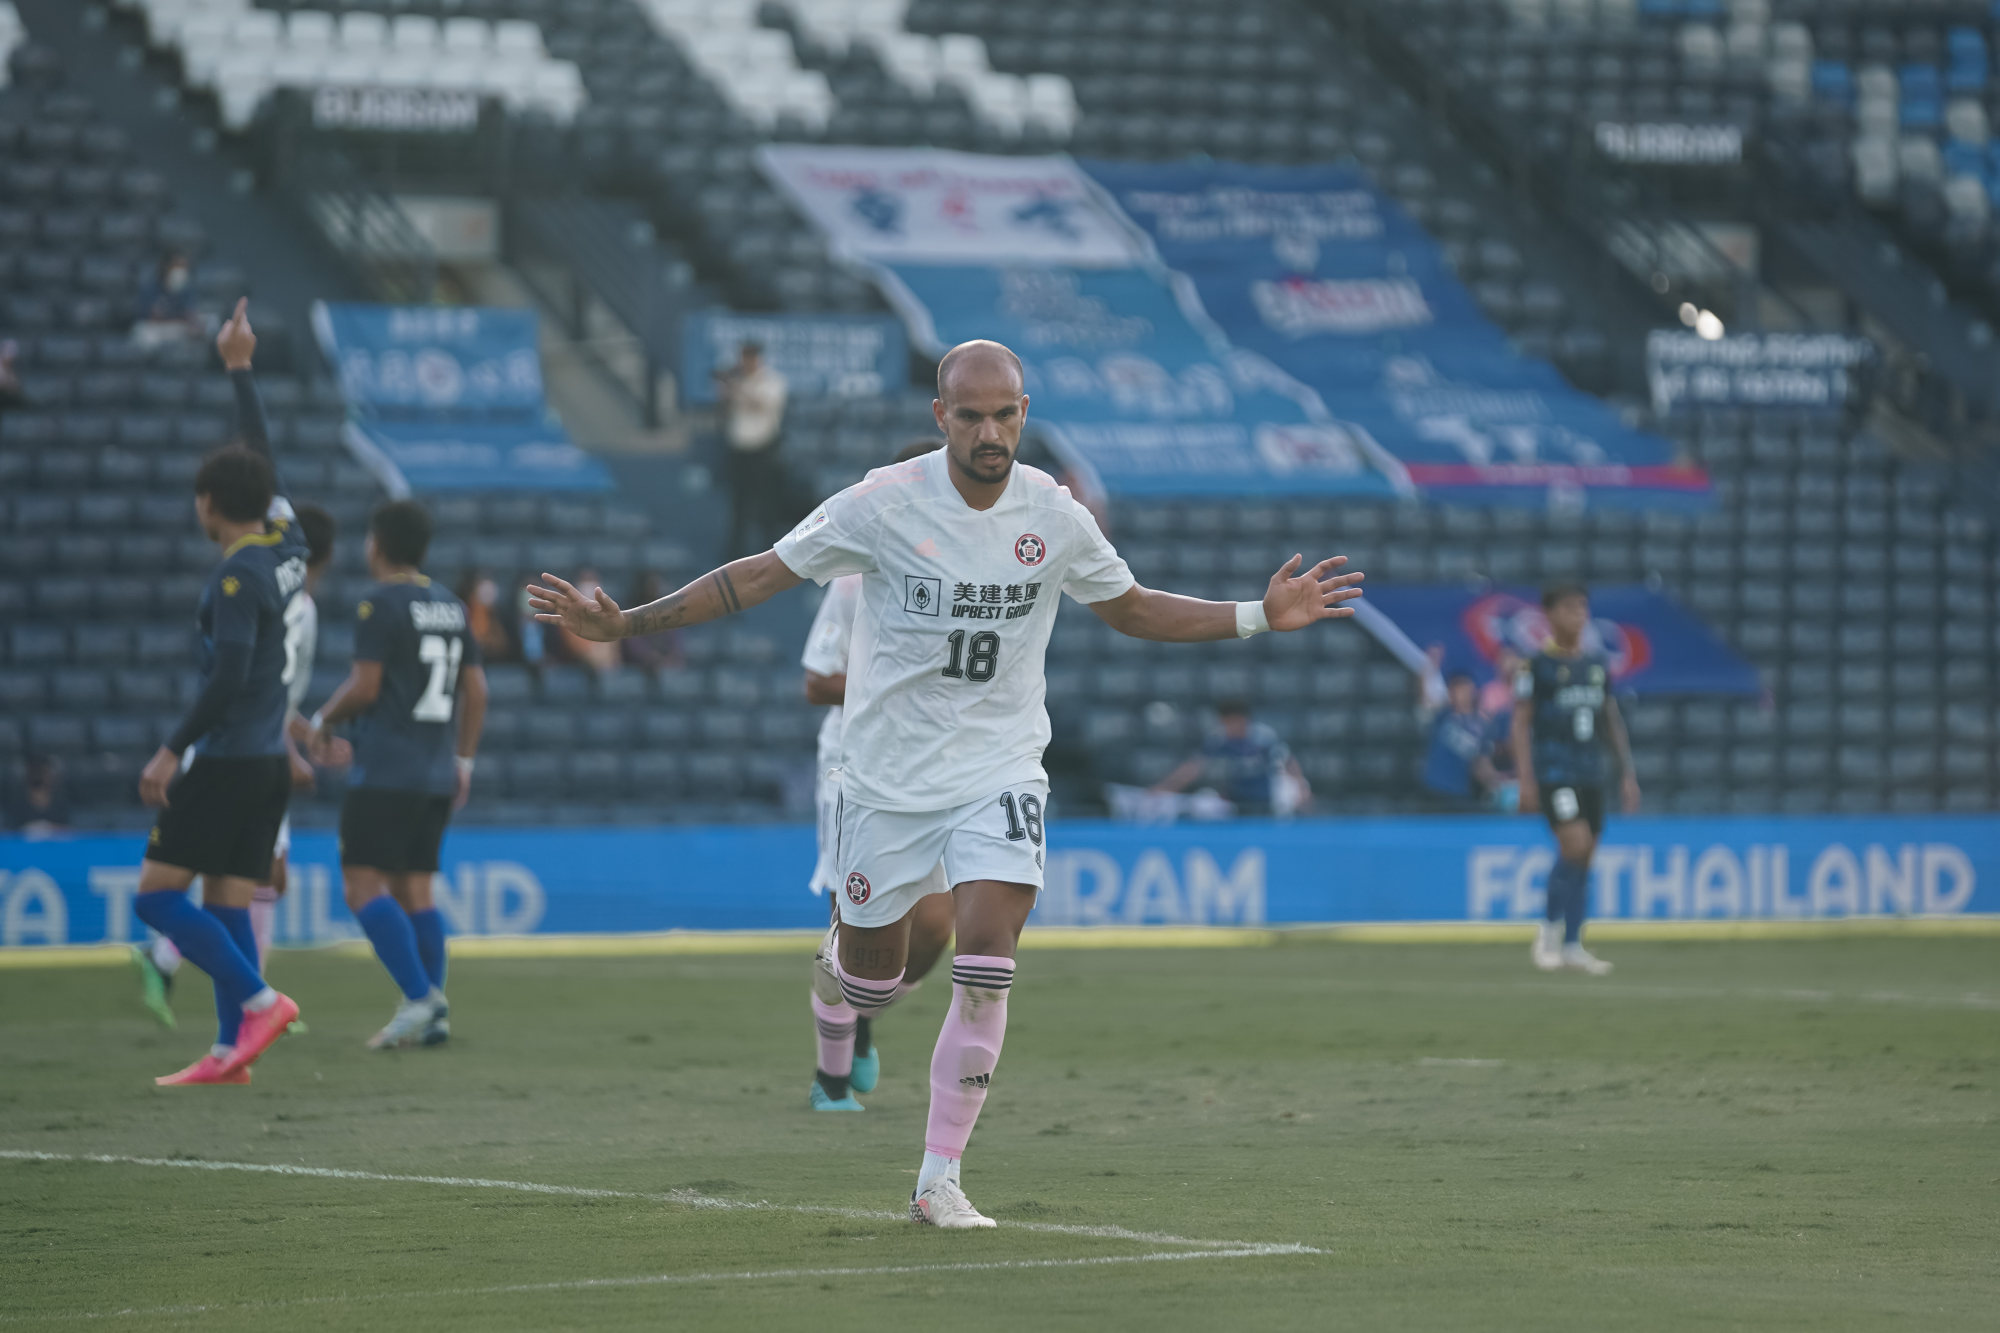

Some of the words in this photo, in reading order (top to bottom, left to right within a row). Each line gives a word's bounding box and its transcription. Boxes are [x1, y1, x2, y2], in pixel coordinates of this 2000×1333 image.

[951, 604, 1003, 619] UPBEST
[953, 582, 1041, 603] 美建集團
[412, 634, 463, 722] 21
[942, 629, 1000, 682] 18
[1000, 791, 1042, 847] 18
[0, 867, 68, 945] A
[1592, 842, 1976, 920] THAILAND
